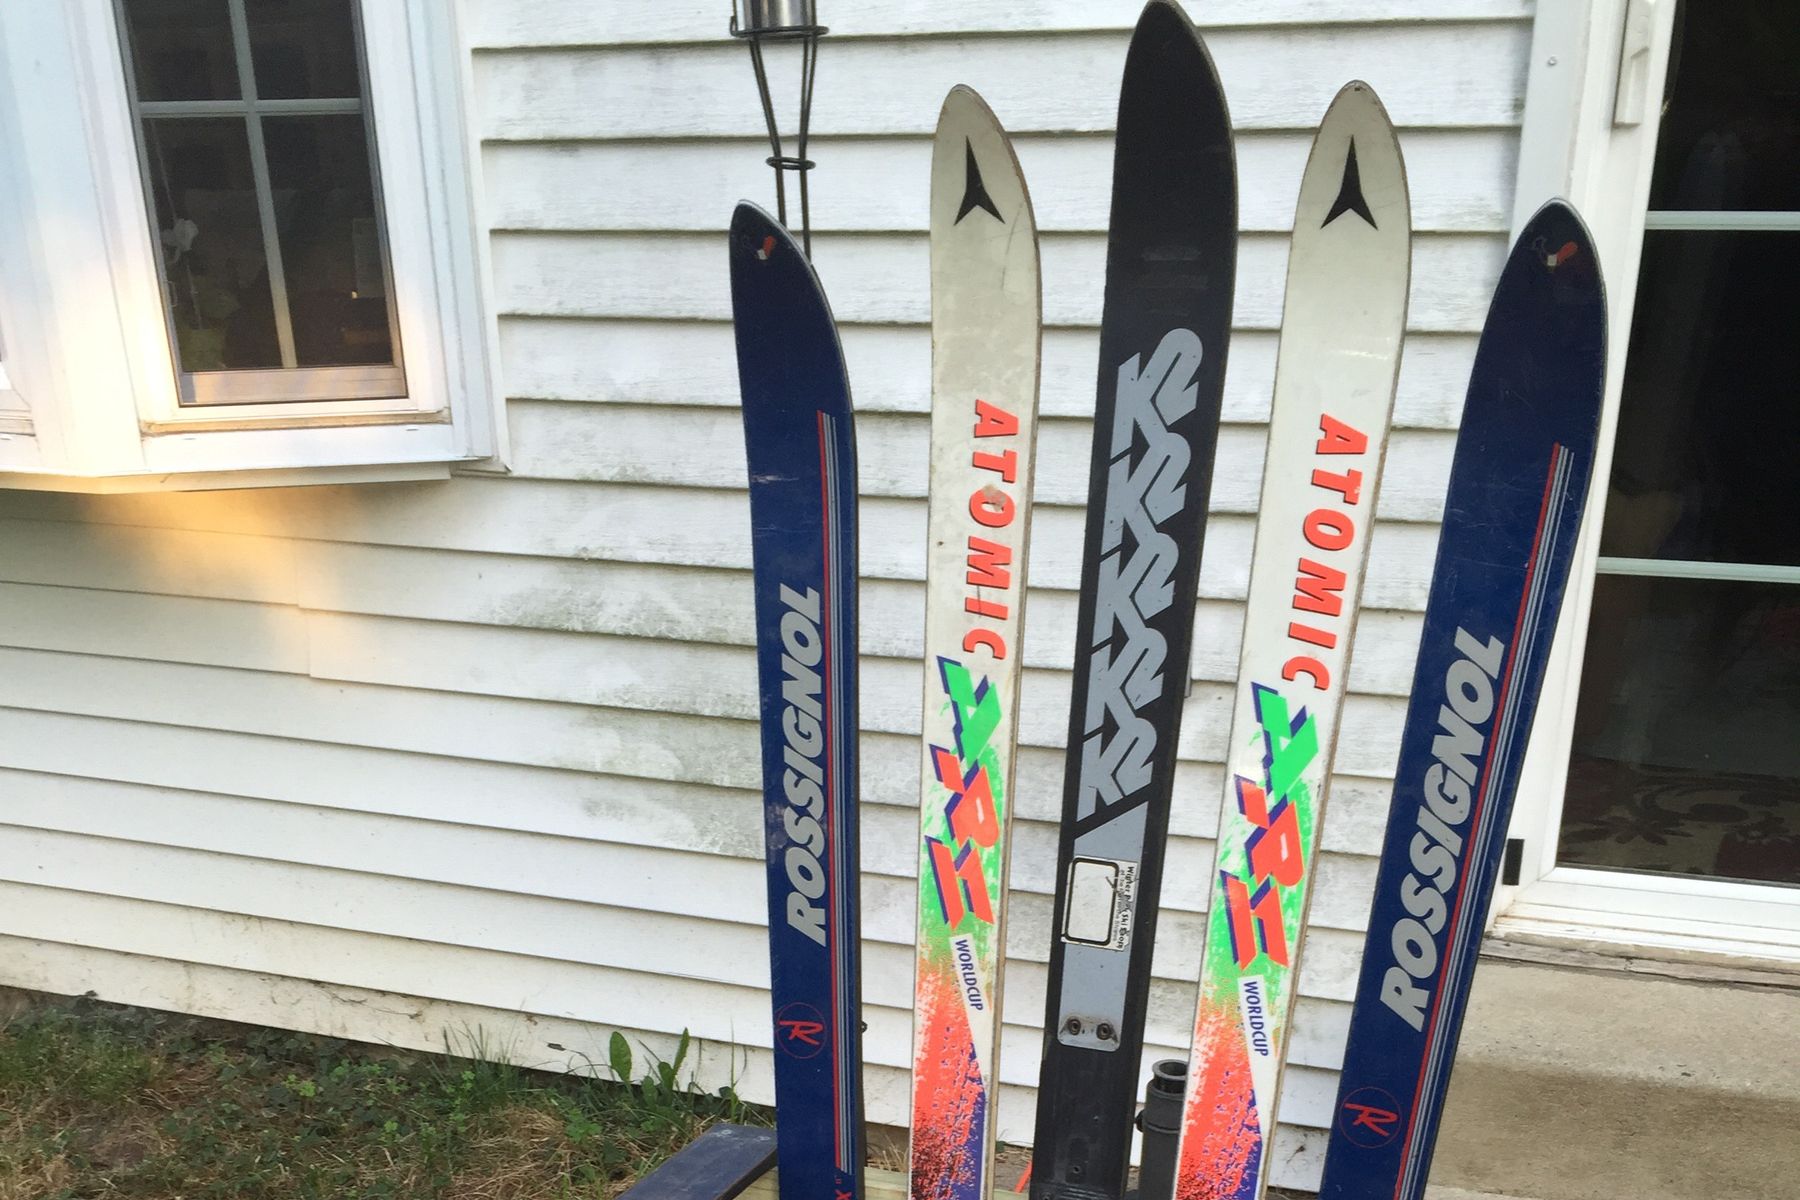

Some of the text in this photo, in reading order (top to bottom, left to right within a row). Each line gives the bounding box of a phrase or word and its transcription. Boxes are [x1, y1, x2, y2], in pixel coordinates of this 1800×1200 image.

[963, 399, 1019, 661] ATOMIC
[1282, 413, 1369, 691] ATOMIC
[779, 583, 827, 947] ROSSIGNOL
[1379, 626, 1505, 1032] ROSSIGNOL
[954, 939, 983, 1012] WORLDCUP
[1243, 980, 1269, 1057] WORLDCUP
